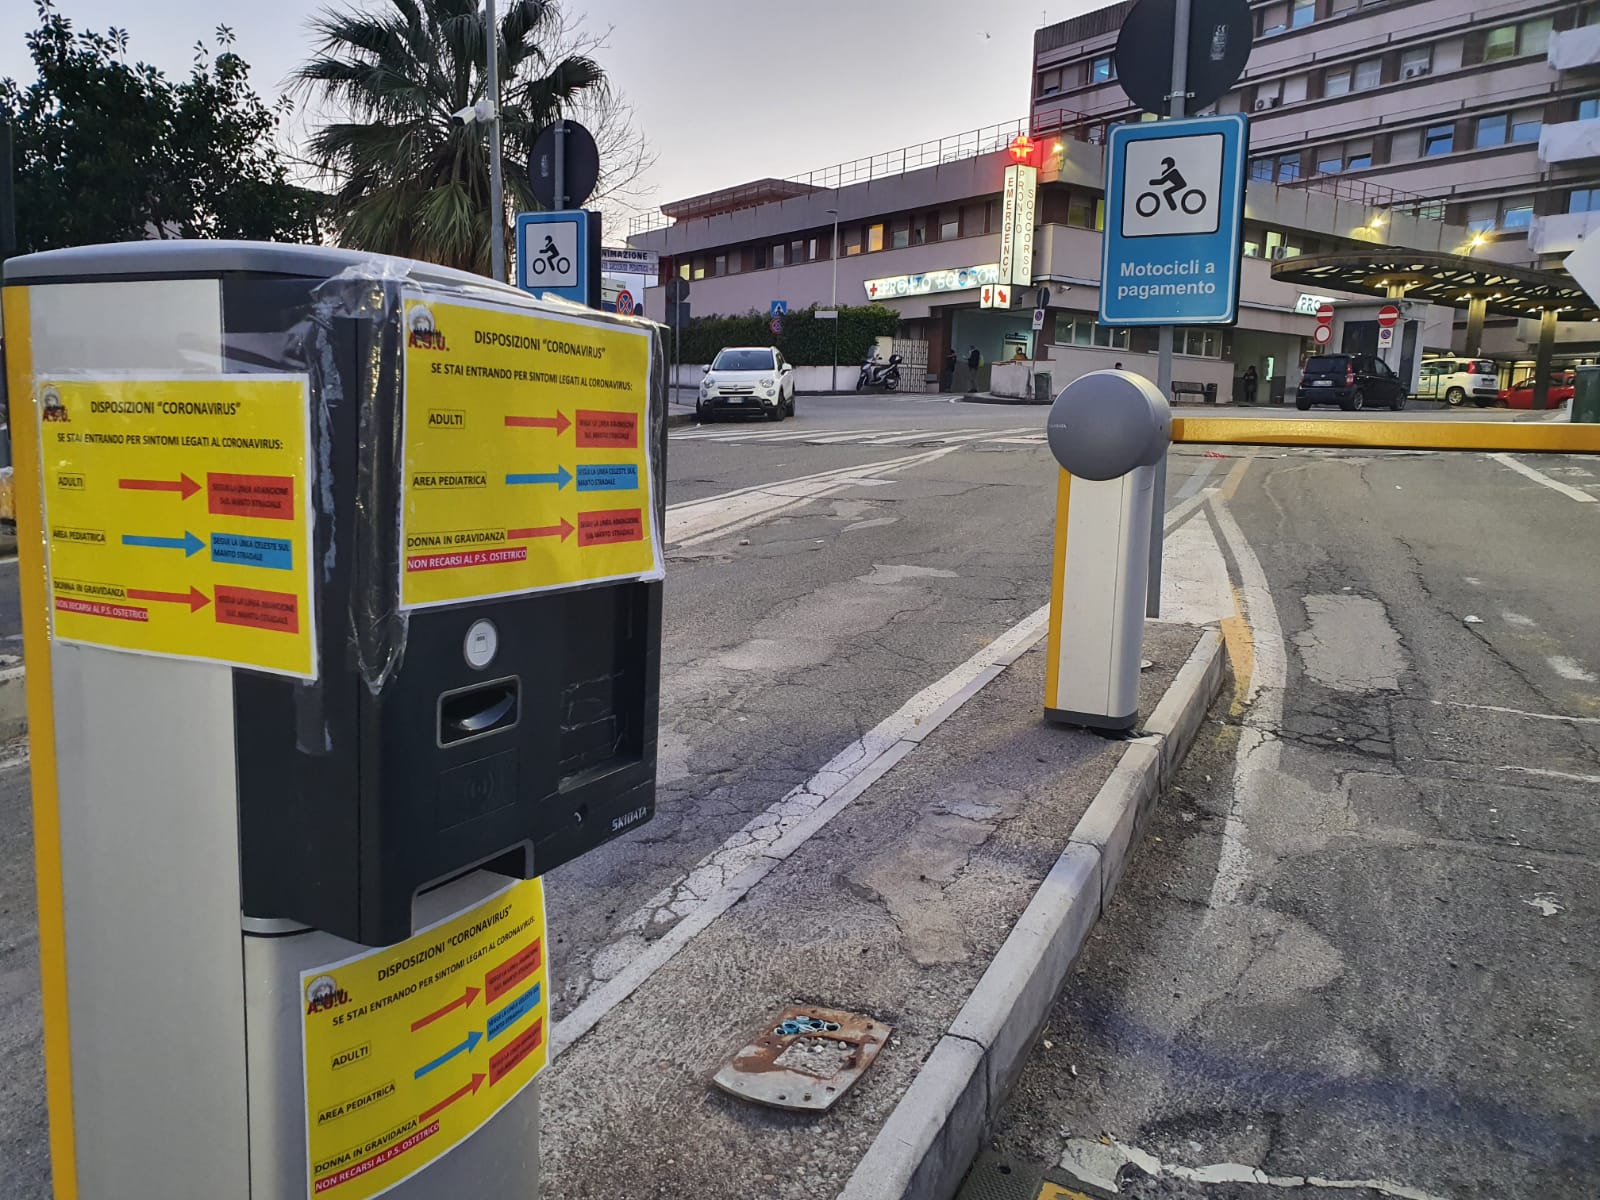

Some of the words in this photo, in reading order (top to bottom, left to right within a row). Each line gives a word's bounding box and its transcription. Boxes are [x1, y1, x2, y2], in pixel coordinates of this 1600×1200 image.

[1016, 170, 1025, 233] PRONTO
[1002, 177, 1014, 277] EMERGENCY
[1023, 189, 1034, 276] SOCCORSO
[1120, 260, 1199, 277] Motocicli
[1205, 262, 1215, 274] a
[1117, 281, 1216, 300] pagamento
[474, 331, 541, 351] DISPOSIZIONI
[431, 362, 442, 374] SE
[444, 363, 464, 375] STAI
[466, 366, 512, 380] ENTRANDO
[514, 370, 528, 381] PER
[529, 371, 558, 384] SINTOMI
[559, 375, 580, 386] LEGATI
[580, 377, 588, 386] AL
[588, 378, 633, 391] CORONAVIRUS:
[90, 401, 155, 415] DISPOSIZIONI
[428, 413, 463, 425] ADULTI
[57, 433, 66, 442] SE
[66, 433, 83, 443] STAI
[84, 434, 124, 445] ENTRANDO
[125, 435, 141, 445] PER
[143, 435, 179, 446] SINTOMI
[181, 436, 209, 447] LEGATI
[211, 437, 221, 448] AL
[222, 437, 284, 450] CORONAVIRUS:
[58, 476, 84, 487] ADULTI
[412, 476, 438, 487] AREA
[439, 475, 487, 486] PEDIATRICA
[53, 530, 68, 538] AREA
[69, 531, 106, 542] PEDIATRICA
[407, 536, 441, 547] DONNA
[443, 535, 453, 544] IN
[454, 531, 505, 544] GRAVIDANZA
[407, 559, 428, 569] NON
[429, 556, 462, 567] RECARSI
[463, 555, 473, 564] AL
[474, 553, 489, 563] P.S.
[489, 550, 527, 561] OSTETRICO
[53, 580, 75, 591] DONNA
[76, 584, 82, 592] IN
[83, 584, 125, 598] GRAVIDANZA
[112, 608, 148, 619] OSTETRICO
[611, 806, 648, 832] SKIDATA
[332, 1014, 344, 1026] SE
[346, 1005, 368, 1021] STAI
[369, 985, 417, 1011] ENTRANDO
[419, 978, 434, 990] PER
[434, 962, 466, 983] SINTOMI
[466, 946, 488, 964] LEGATI
[488, 942, 496, 952] AL
[496, 915, 536, 946] CORONAVIRUS:
[377, 943, 445, 982] DISPOSIZIONI
[331, 1046, 369, 1068] ADULTI
[318, 1107, 344, 1124] AREA
[346, 1083, 396, 1112] PEDIATRICA
[314, 1153, 351, 1175] DONNA
[353, 1147, 363, 1157] IN
[364, 1119, 417, 1152] GRAVIDANZA
[315, 1176, 337, 1191] NON
[339, 1159, 375, 1182] RECARSI
[375, 1153, 386, 1163] AL
[387, 1146, 401, 1158] P.S.
[402, 1122, 439, 1150] OSTETRICO
